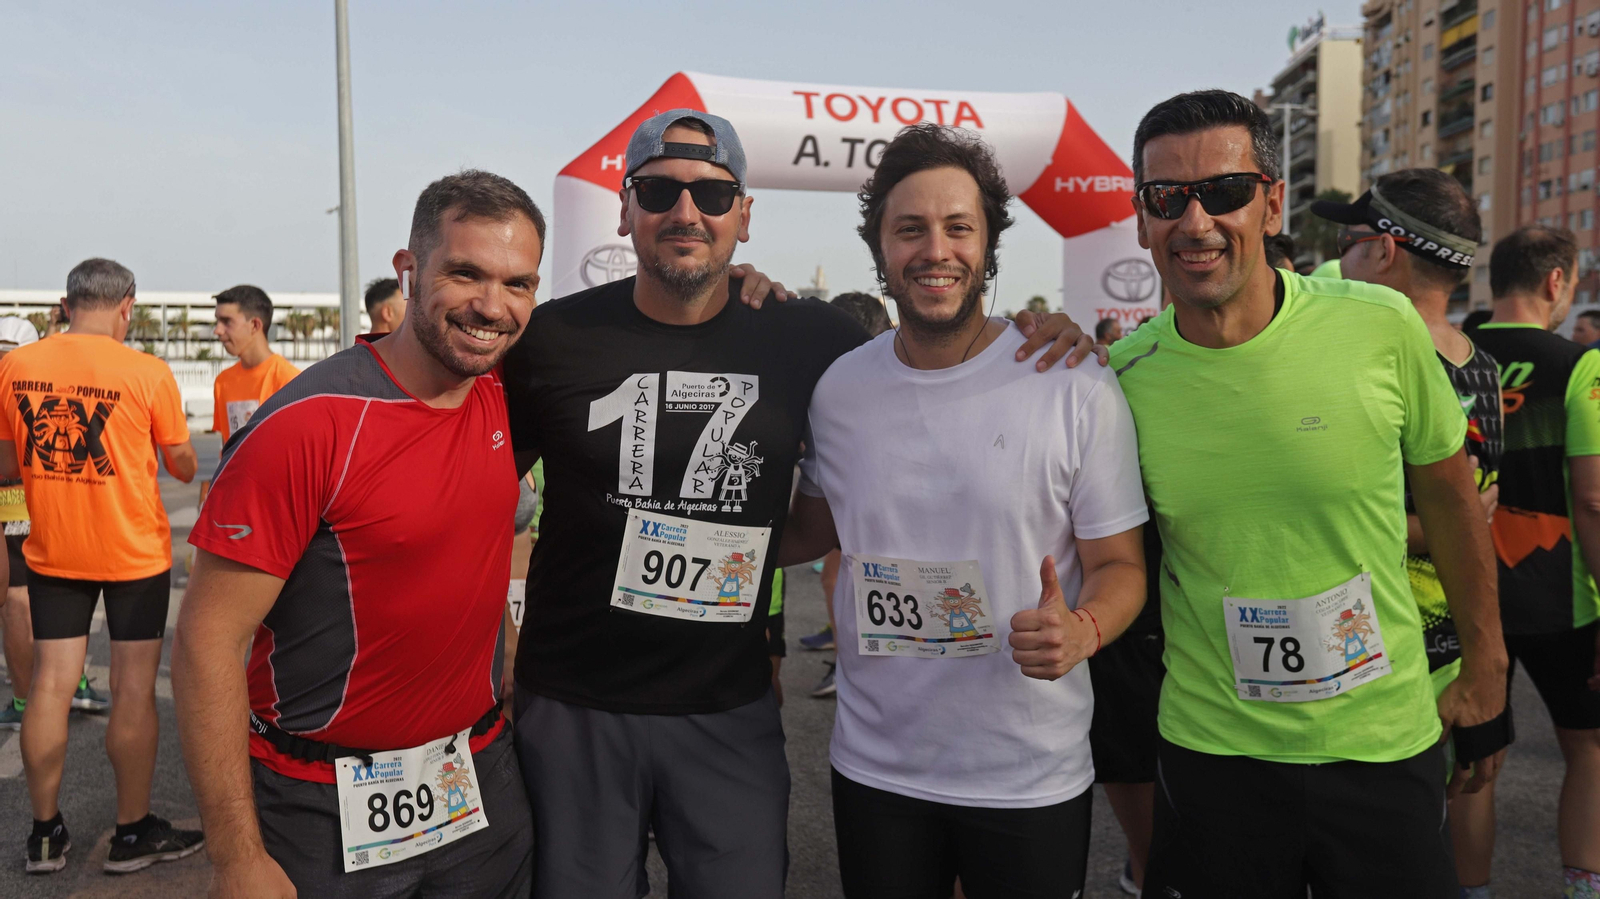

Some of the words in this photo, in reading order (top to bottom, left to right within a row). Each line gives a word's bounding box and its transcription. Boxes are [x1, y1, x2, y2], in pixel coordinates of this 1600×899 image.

[793, 91, 984, 129] TOYOTA
[792, 135, 829, 167] A.
[12, 380, 54, 393] CARRERA
[76, 385, 121, 402] POPULAR
[671, 389, 716, 399] Algeciras
[628, 375, 649, 490] CARRERA
[692, 381, 754, 494] POPULAR
[663, 500, 675, 510] de
[639, 519, 662, 537] XX
[661, 523, 687, 534] Carrera
[660, 530, 687, 542] Popular
[714, 530, 746, 539] ALESSIO
[641, 550, 711, 592] 907
[862, 562, 880, 578] XX
[1315, 588, 1348, 608] ANTONIO
[676, 606, 699, 614] Algeciras
[867, 590, 923, 631] 633
[1238, 606, 1259, 623] XX
[1259, 616, 1289, 624] Popular
[1253, 636, 1305, 673] 78
[374, 761, 402, 770] Carrera
[375, 769, 404, 779] Popular
[368, 783, 434, 833] 869
